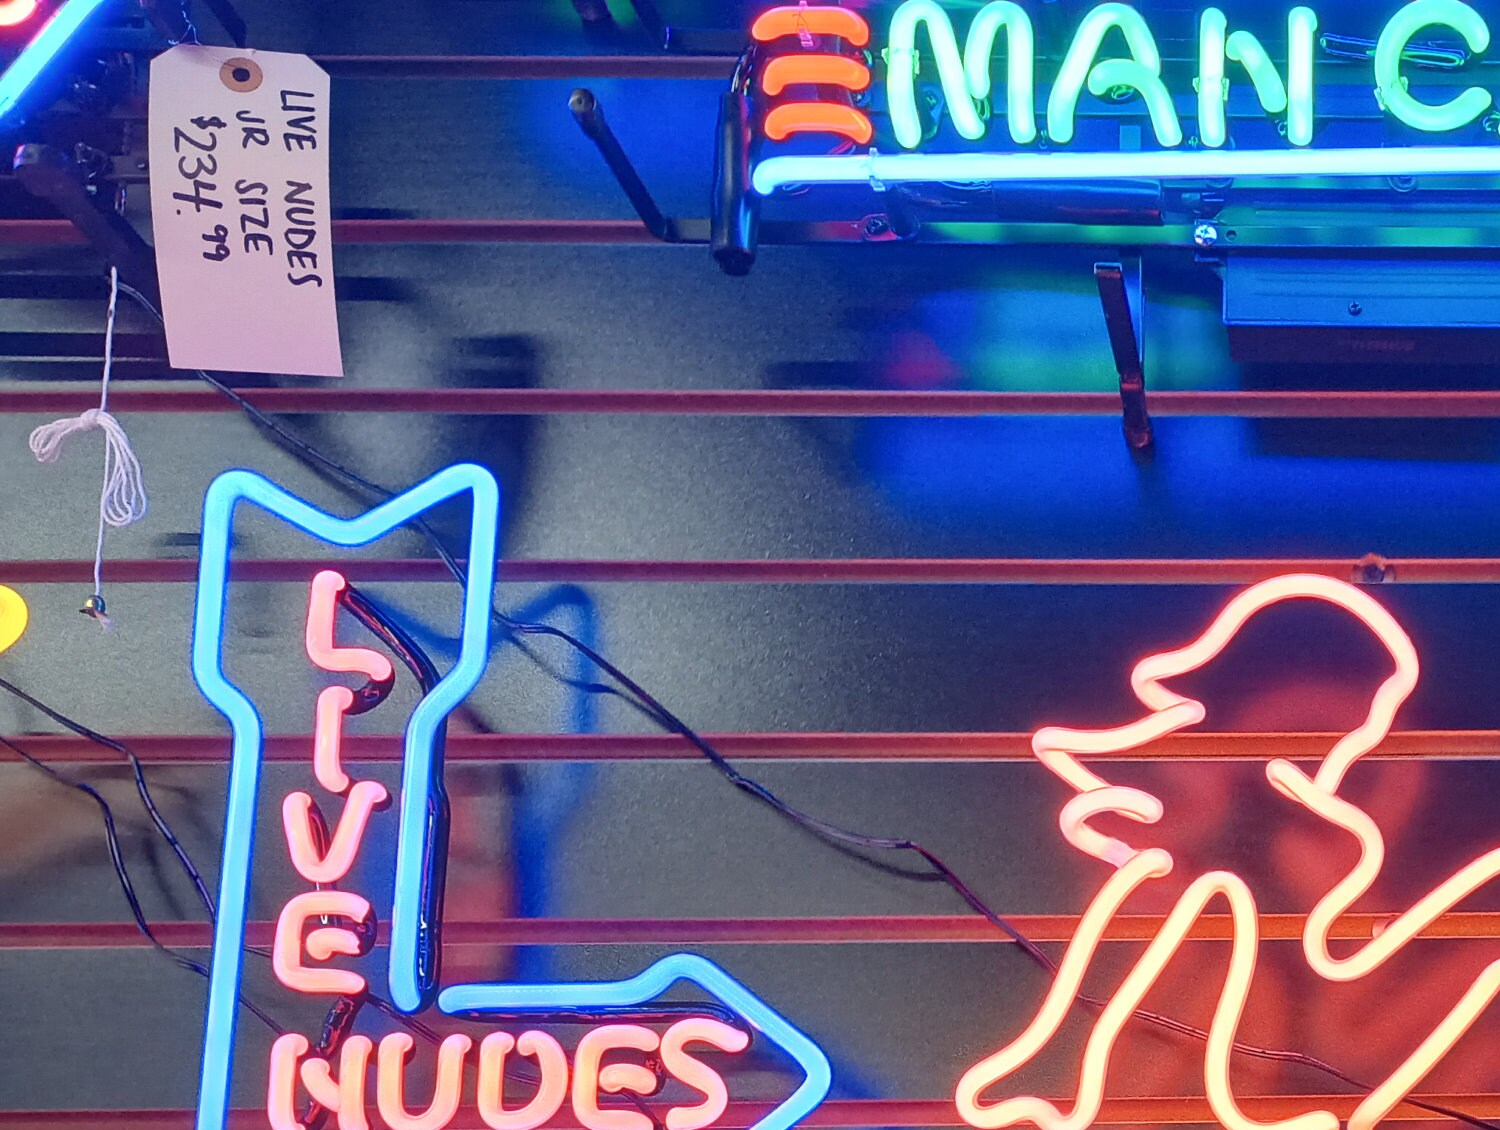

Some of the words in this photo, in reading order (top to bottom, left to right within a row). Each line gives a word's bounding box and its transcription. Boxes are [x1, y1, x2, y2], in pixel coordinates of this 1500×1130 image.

[280, 89, 317, 152] LIVE
[886, 0, 1317, 149] MAN
[235, 110, 270, 149] JR
[173, 115, 231, 262] $234.99
[234, 179, 274, 256] SIZE
[283, 180, 323, 288] NUDES
[272, 569, 393, 995] LIVE
